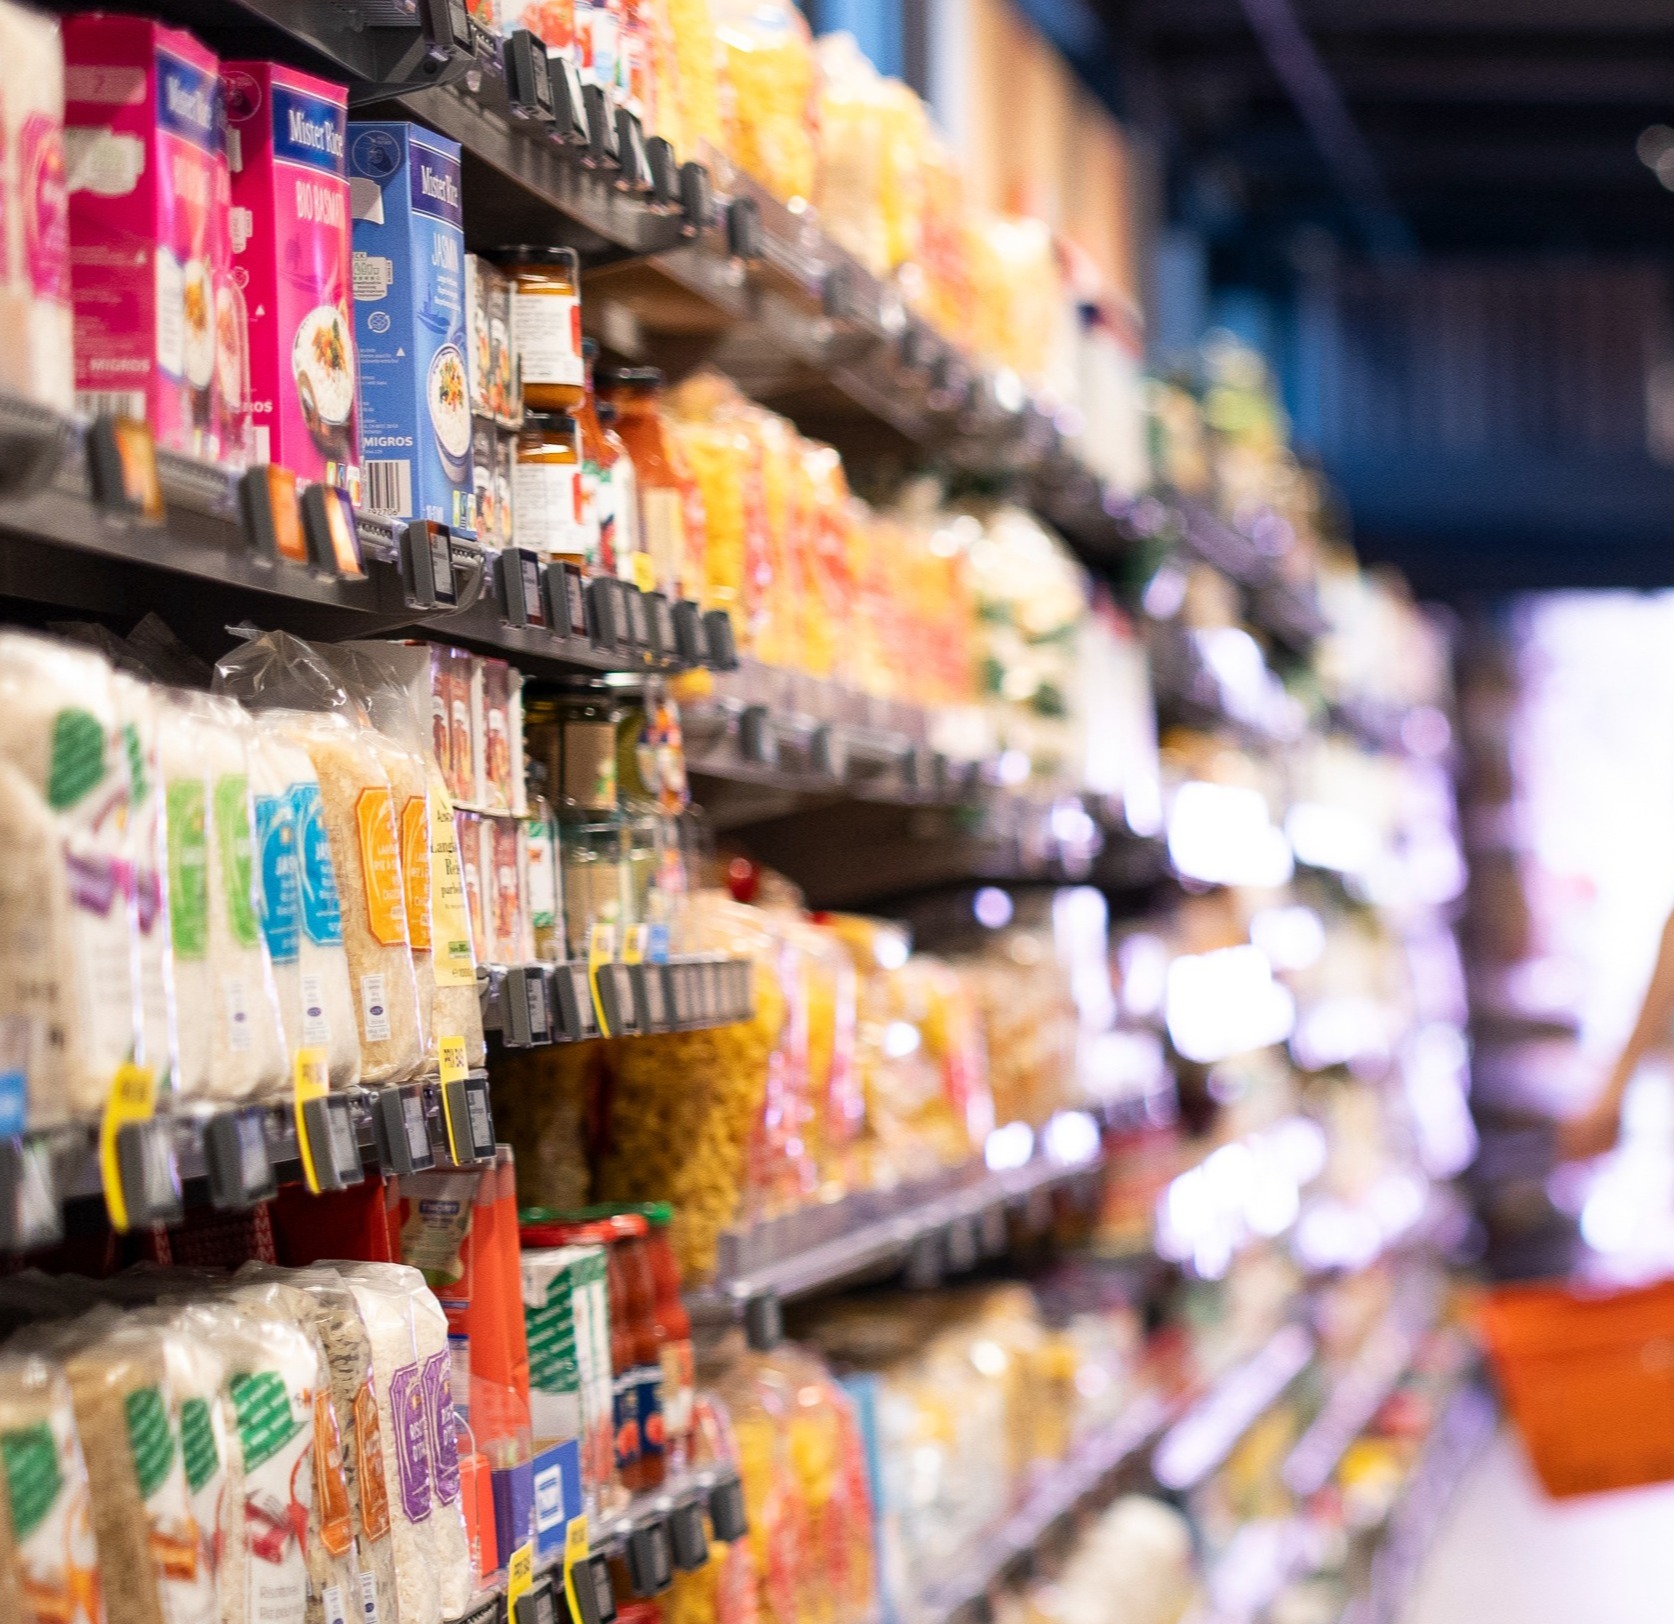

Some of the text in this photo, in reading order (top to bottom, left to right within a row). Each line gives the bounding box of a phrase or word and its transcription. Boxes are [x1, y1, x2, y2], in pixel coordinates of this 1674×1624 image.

[289, 108, 344, 158] Mister Rice
[295, 180, 314, 221] BIO
[420, 164, 447, 203] Mister
[364, 436, 413, 447] MIGROS
